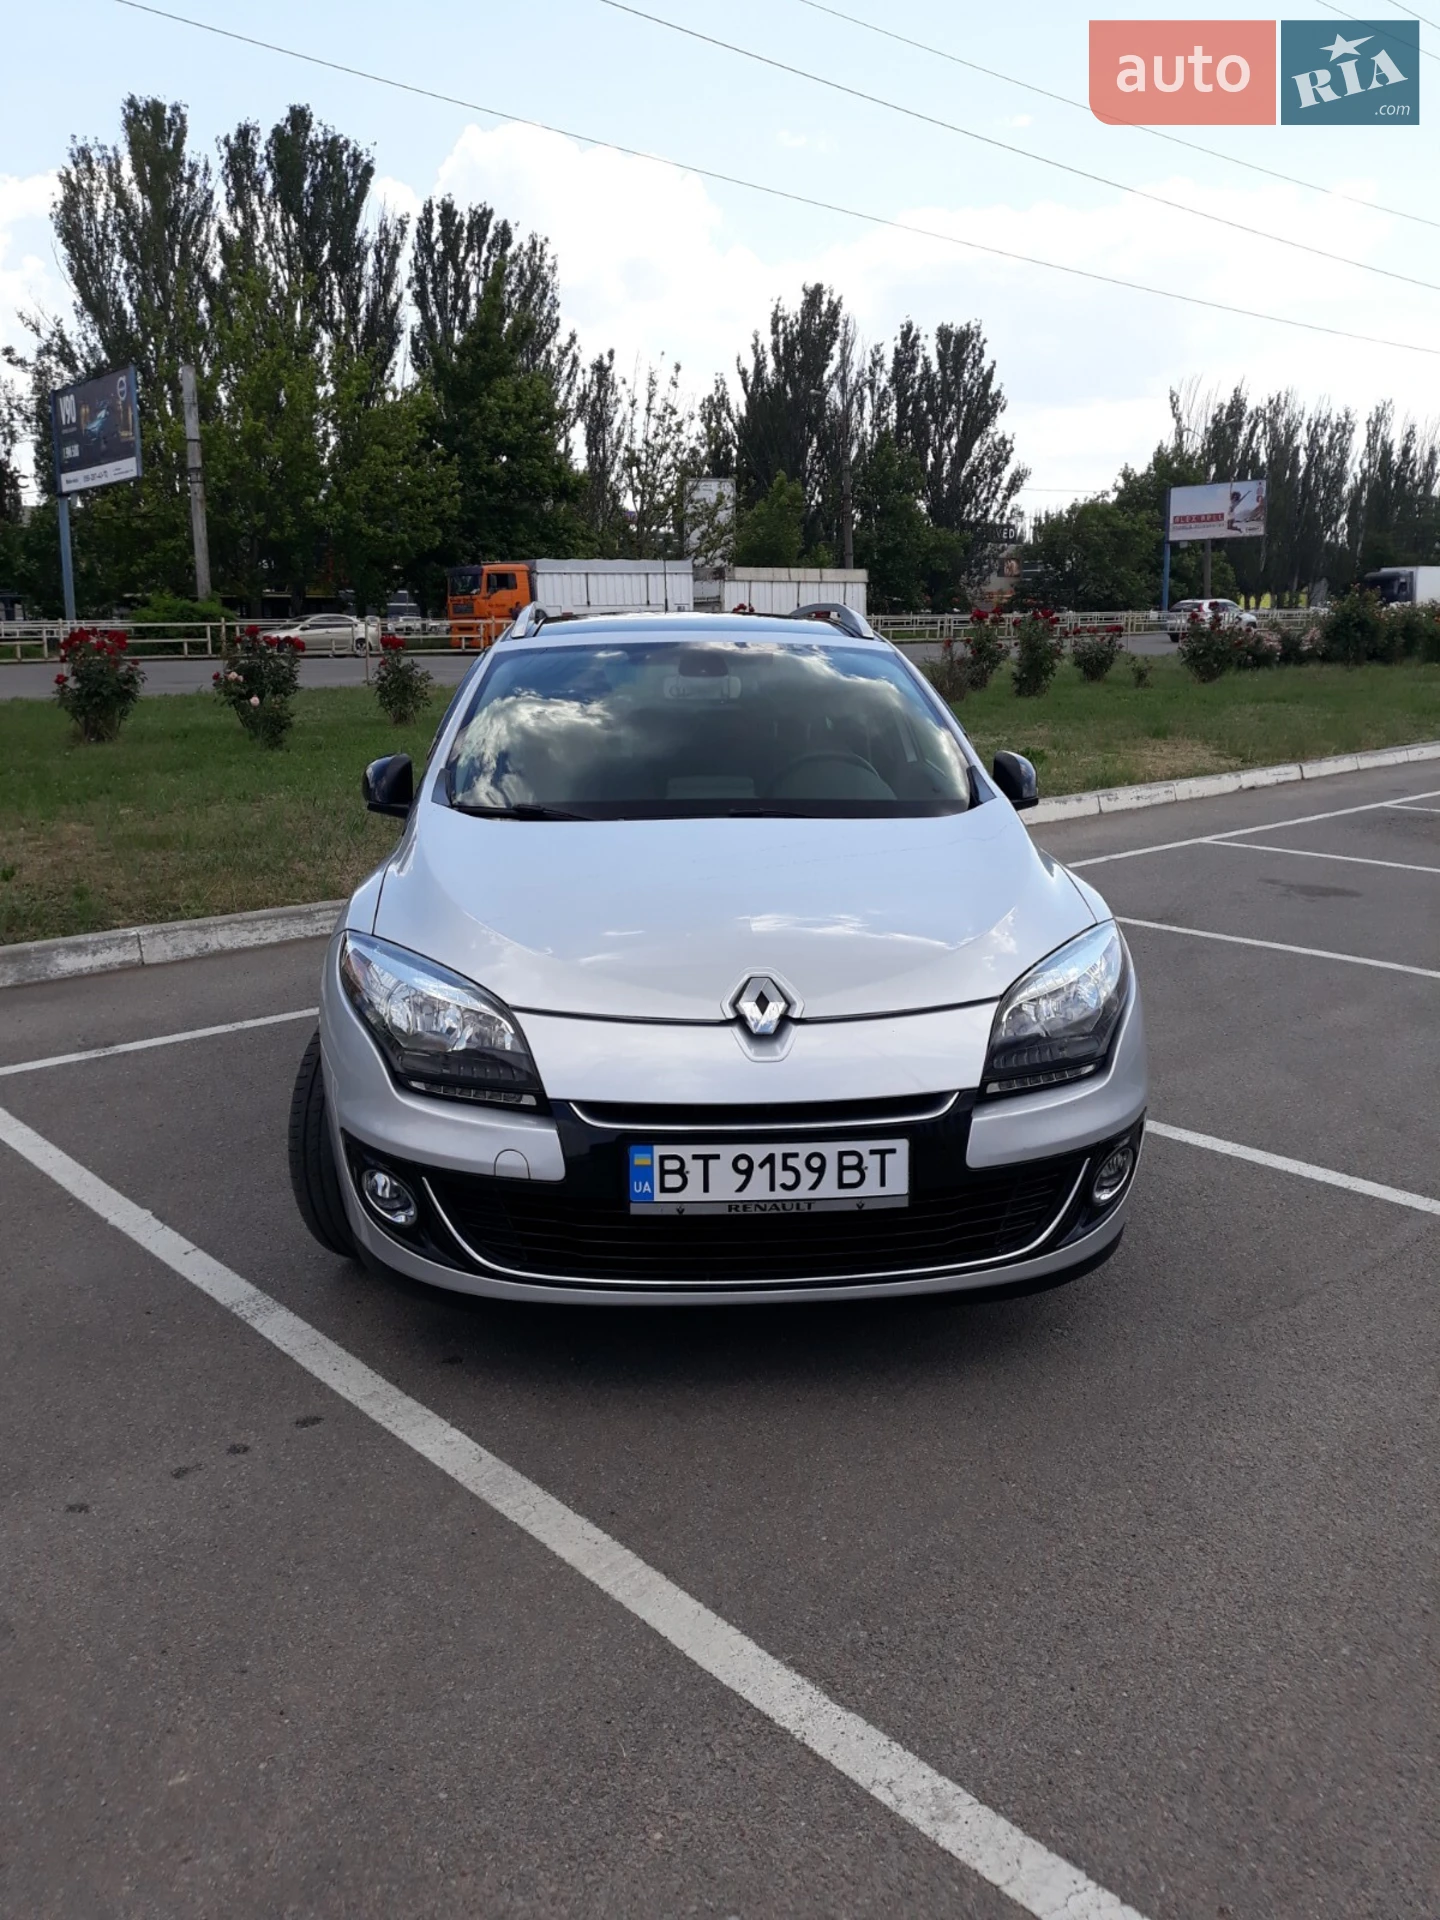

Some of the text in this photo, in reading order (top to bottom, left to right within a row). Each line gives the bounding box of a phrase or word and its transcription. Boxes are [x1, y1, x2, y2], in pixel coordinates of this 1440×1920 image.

[59, 394, 77, 426] V90
[658, 1148, 897, 1194] BT 9159 BT
[633, 1181, 652, 1194] UA
[727, 1201, 817, 1213] RENAULT
